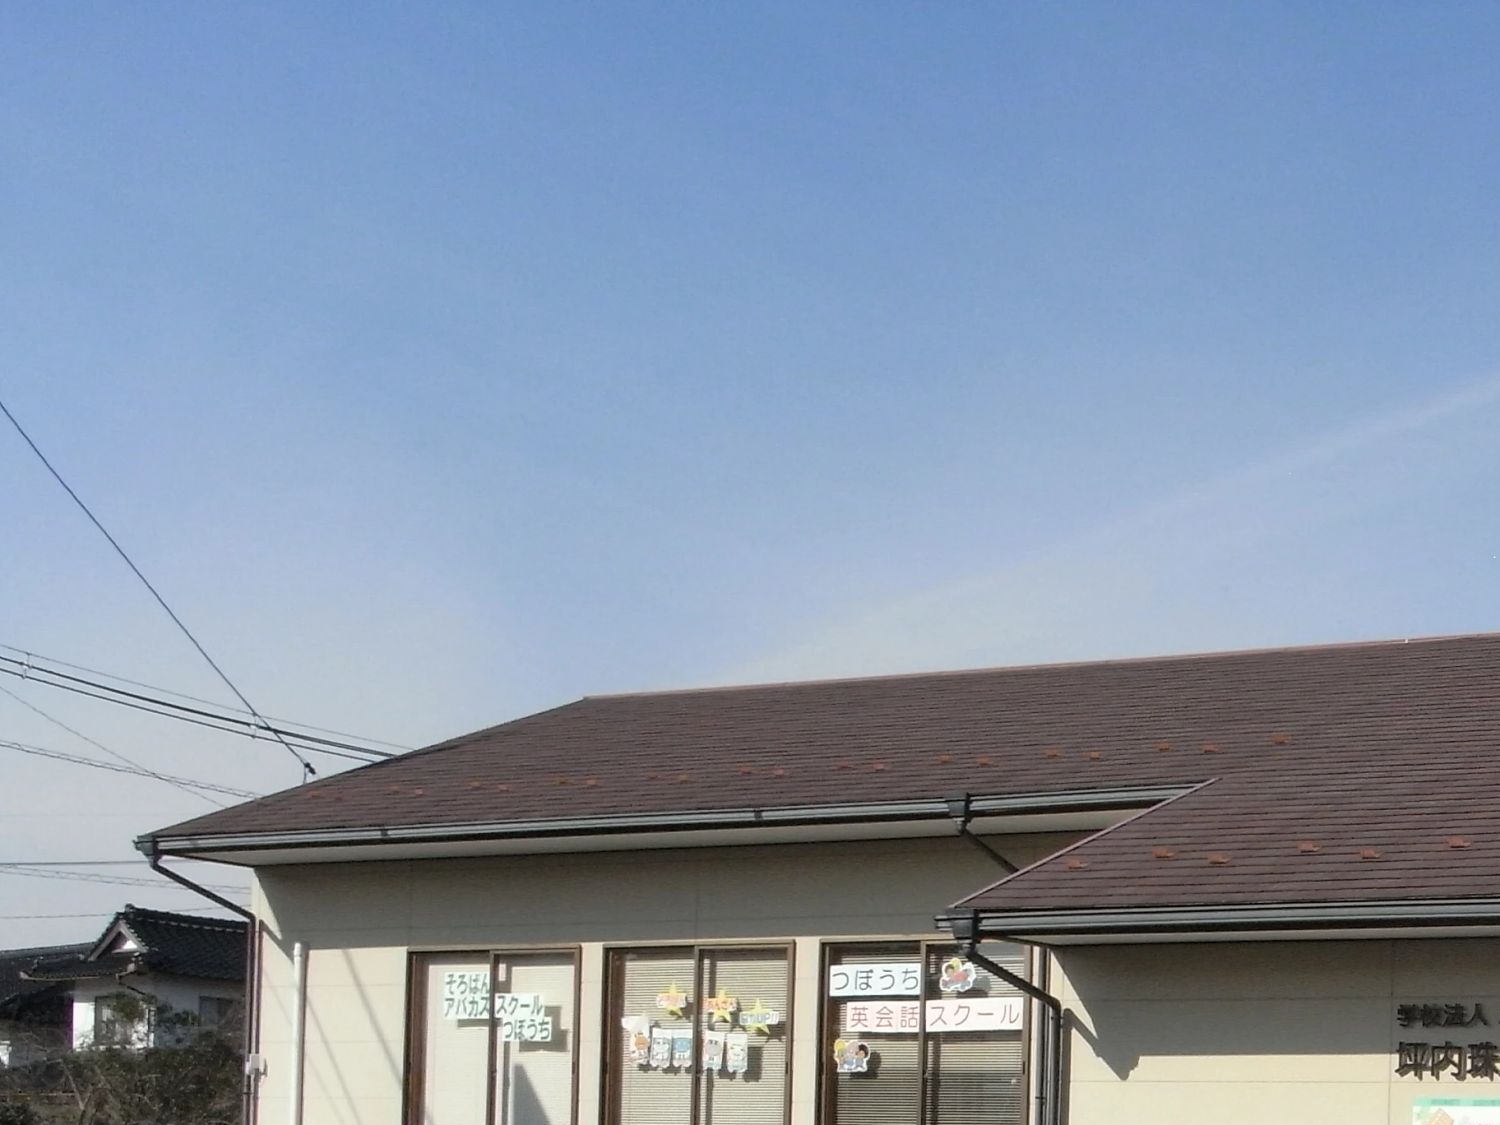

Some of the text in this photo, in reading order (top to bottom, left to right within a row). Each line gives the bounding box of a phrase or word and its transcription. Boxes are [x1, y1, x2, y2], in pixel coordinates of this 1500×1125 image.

[444, 973, 491, 995] そろばん
[831, 967, 919, 991] つぼうち
[850, 1003, 1020, 1029] 英会話スクール
[1396, 1002, 1489, 1027] 学校法人
